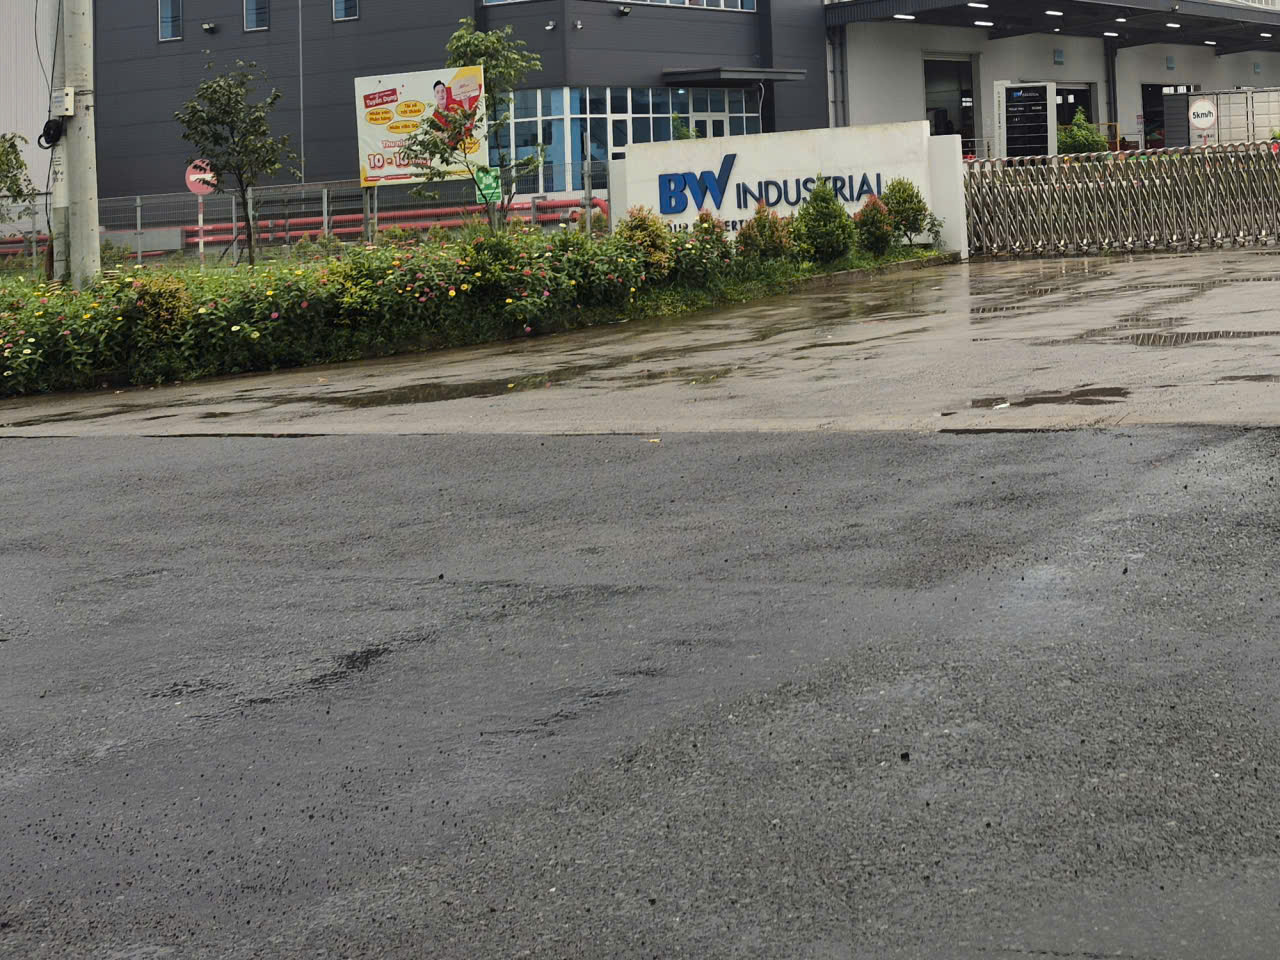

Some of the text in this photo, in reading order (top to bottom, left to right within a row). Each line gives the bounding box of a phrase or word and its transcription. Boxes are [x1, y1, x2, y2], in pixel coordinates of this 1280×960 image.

[1192, 110, 1213, 120] 5km/h
[368, 153, 384, 168] 10
[659, 153, 736, 214] BW
